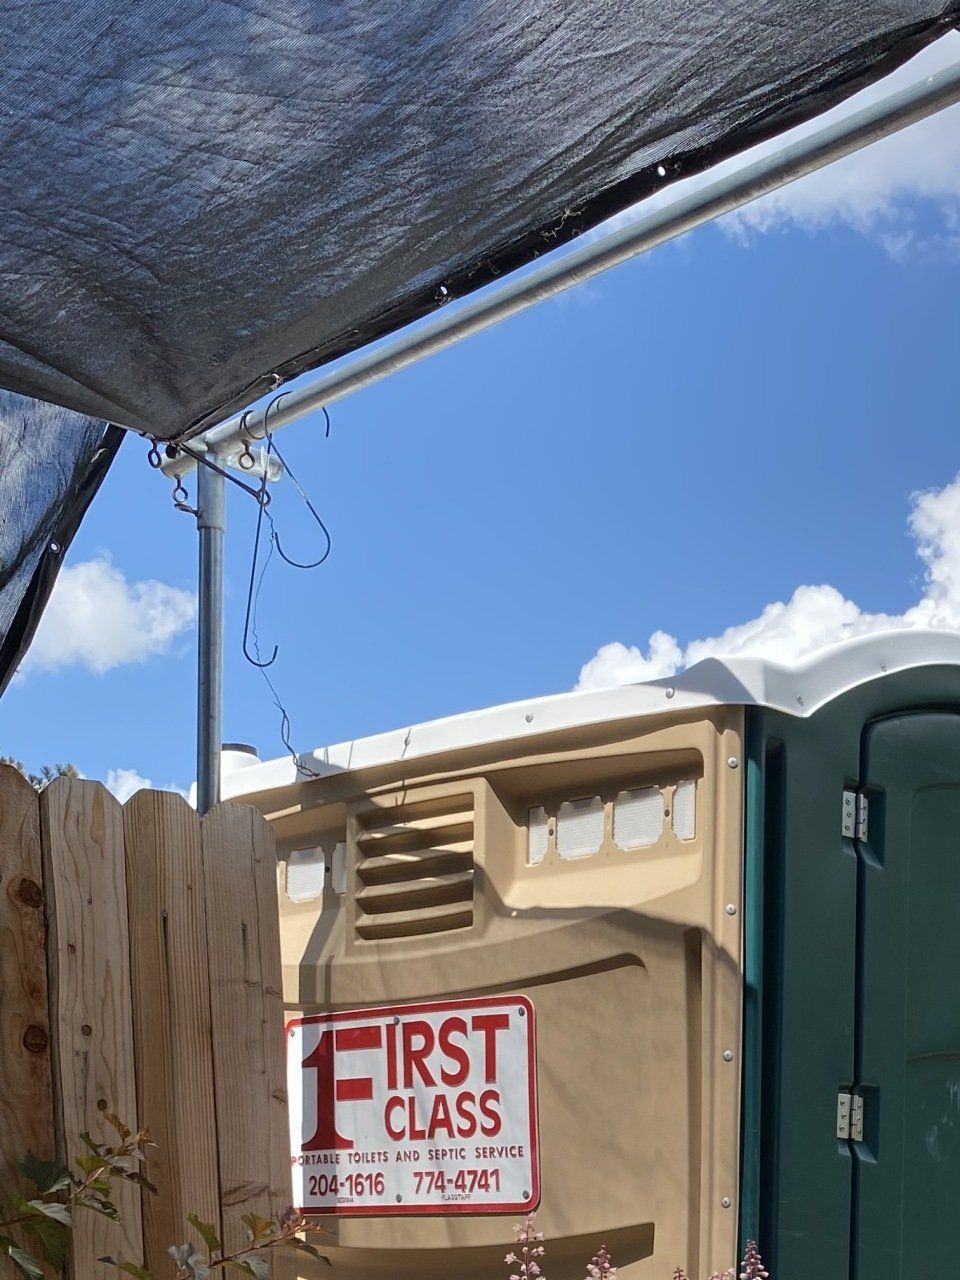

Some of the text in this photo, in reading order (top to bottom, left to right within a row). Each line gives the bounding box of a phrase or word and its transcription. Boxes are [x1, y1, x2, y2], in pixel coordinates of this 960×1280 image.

[385, 1089, 501, 1141] CLASS
[290, 1145, 524, 1167] PORTABLE TOILETS AND SEPTIC SERVICE
[309, 1168, 501, 1197] 204-1616 774-4741
